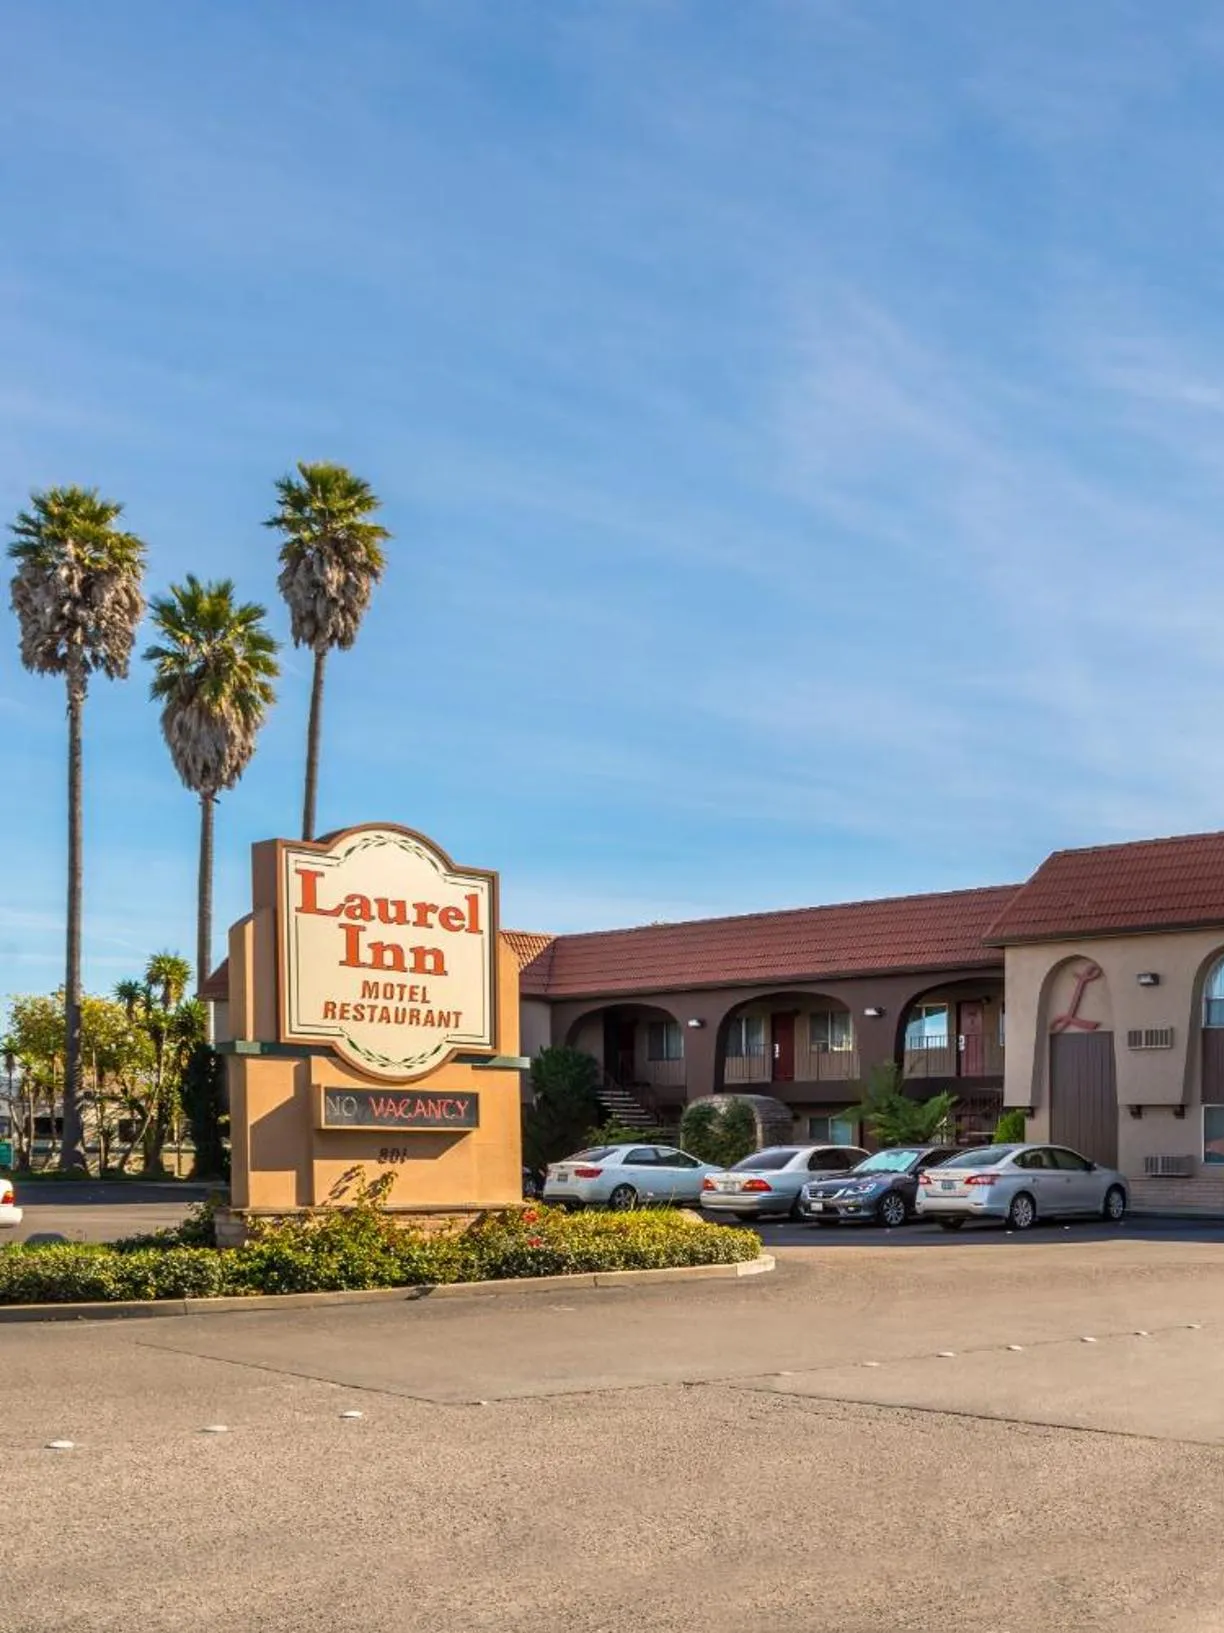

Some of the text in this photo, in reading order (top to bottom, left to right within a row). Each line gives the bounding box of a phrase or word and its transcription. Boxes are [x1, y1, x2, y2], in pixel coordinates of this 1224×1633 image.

[295, 868, 484, 935] Laurel
[339, 923, 448, 976] Inn
[361, 980, 430, 1004] MOTEL
[323, 1000, 463, 1029] RESTAURANT
[325, 1094, 469, 1121] NO VACANCY
[376, 1147, 408, 1165] 801
